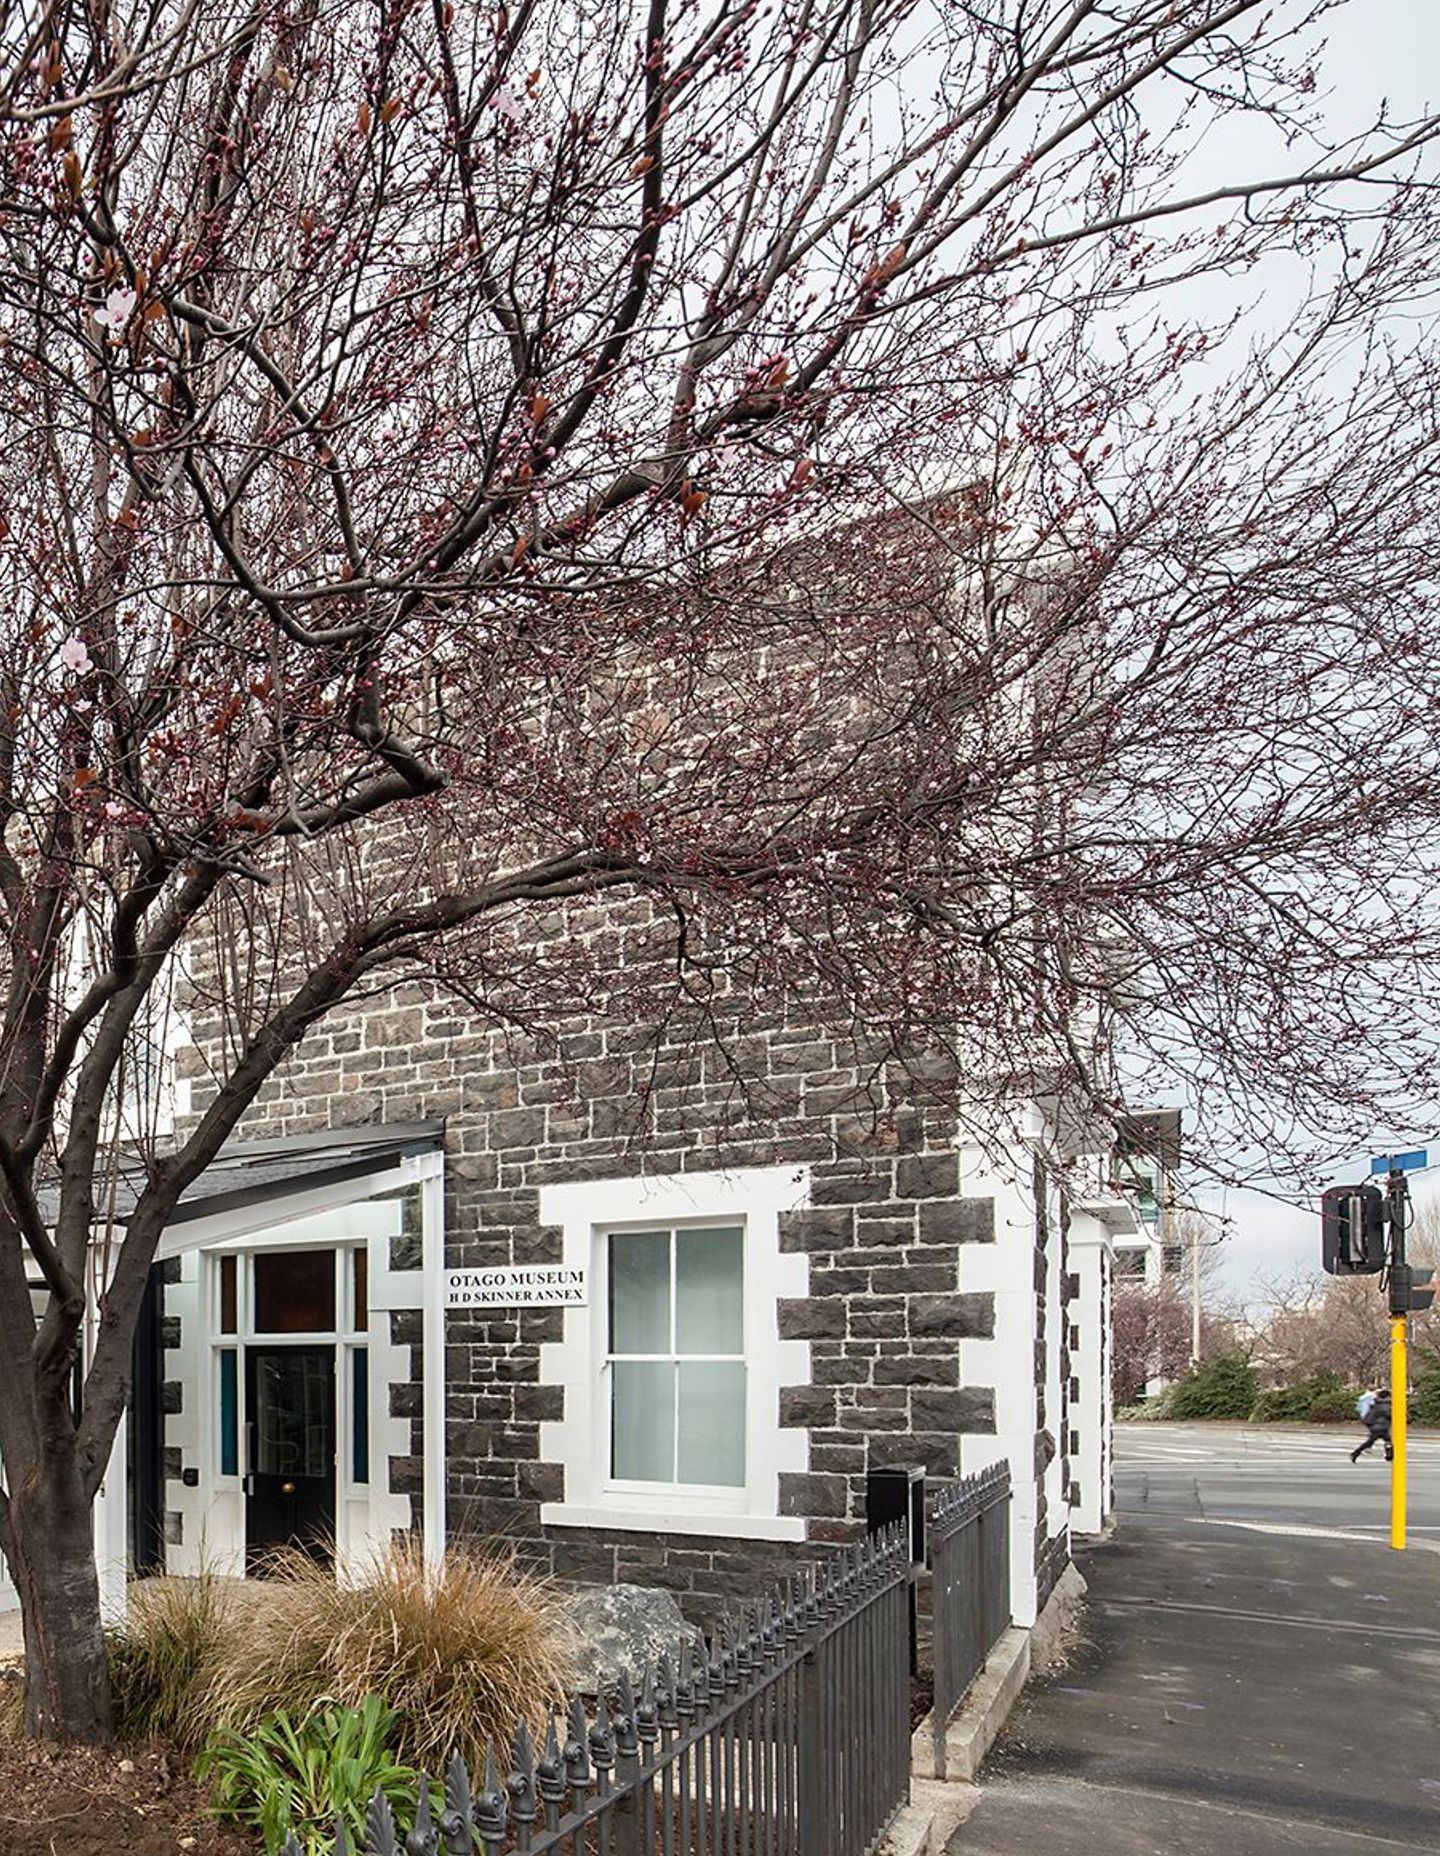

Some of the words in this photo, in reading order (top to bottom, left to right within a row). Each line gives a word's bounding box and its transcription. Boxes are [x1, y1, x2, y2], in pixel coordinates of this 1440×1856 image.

[449, 1274, 506, 1287] OTAGO
[511, 1271, 584, 1285] MUSEUM
[449, 1291, 459, 1303] H
[462, 1290, 471, 1302] D
[474, 1290, 532, 1302] SKINNER
[536, 1288, 583, 1301] ANNEX
